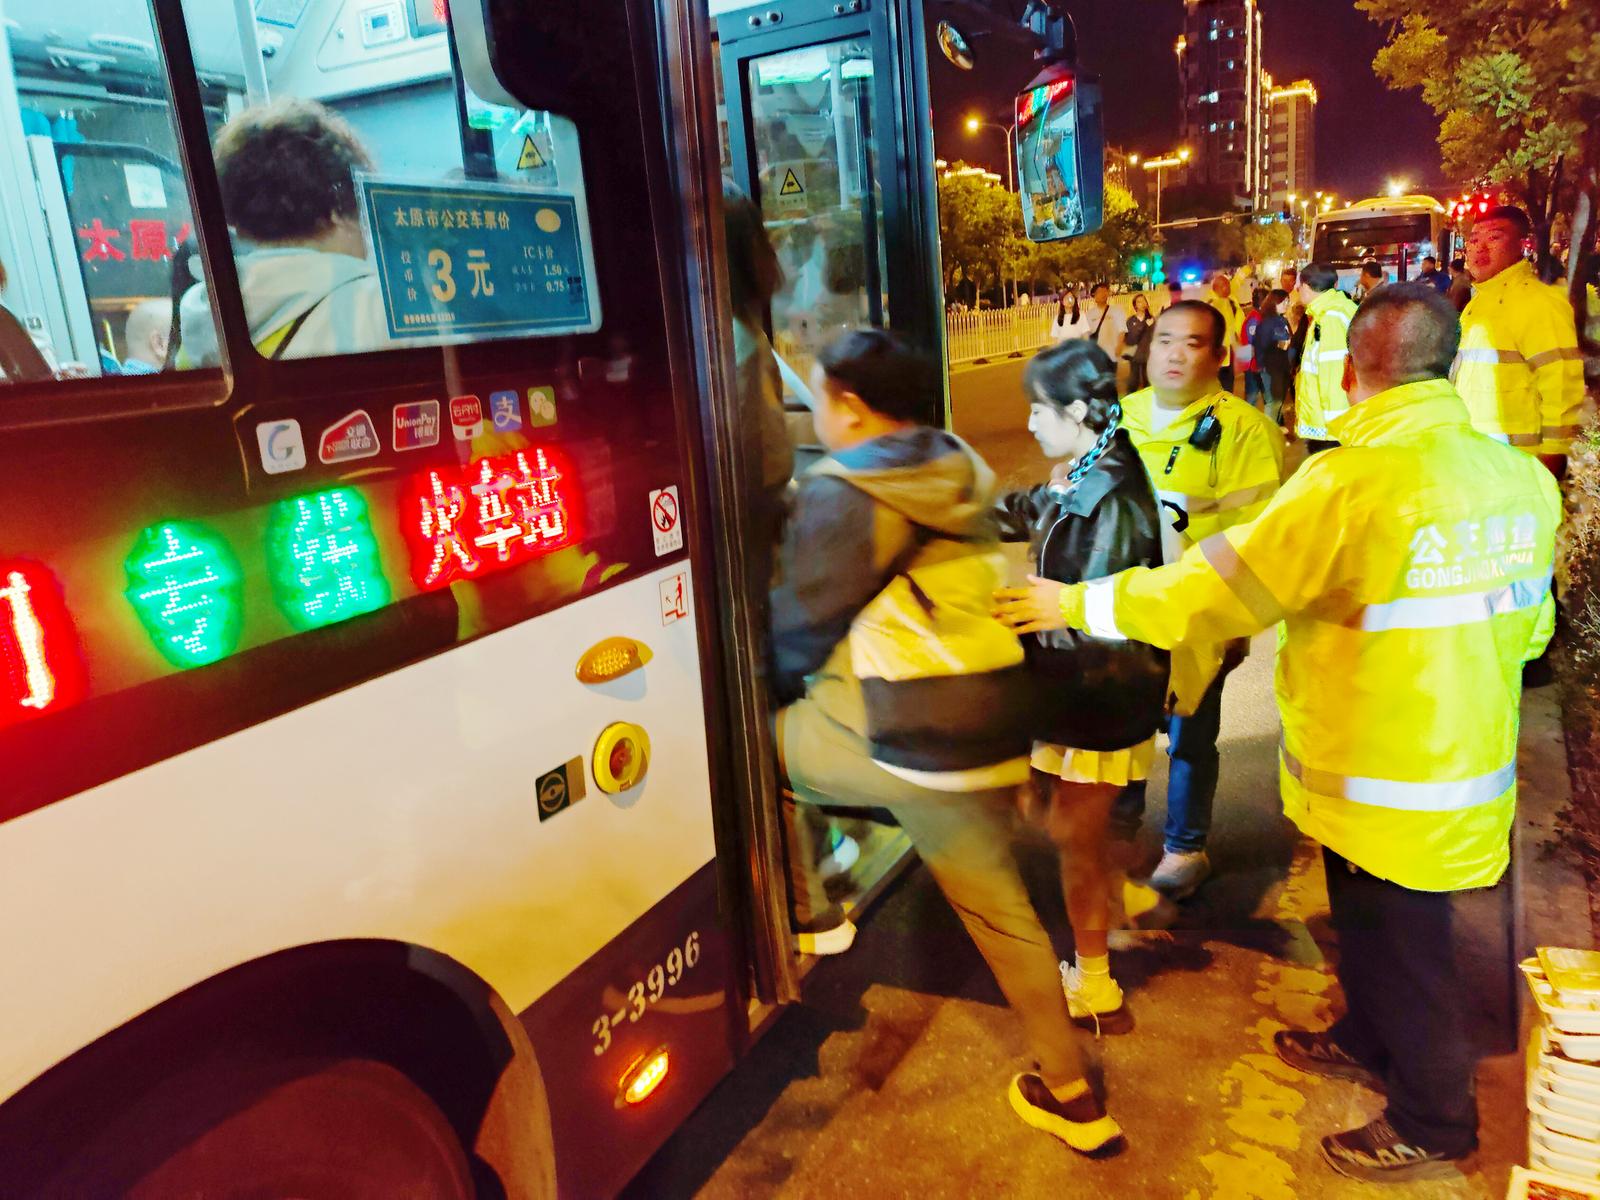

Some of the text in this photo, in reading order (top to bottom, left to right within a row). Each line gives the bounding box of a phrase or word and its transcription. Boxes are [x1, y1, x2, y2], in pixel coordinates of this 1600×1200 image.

[393, 207, 510, 231] 太原市公交车票价
[78, 218, 191, 262] 太原
[427, 248, 495, 303] 3 元
[543, 264, 563, 276] 1.50
[545, 281, 566, 293] 0.75
[396, 411, 437, 430] UnionPay
[592, 930, 701, 1056] 3-3996
